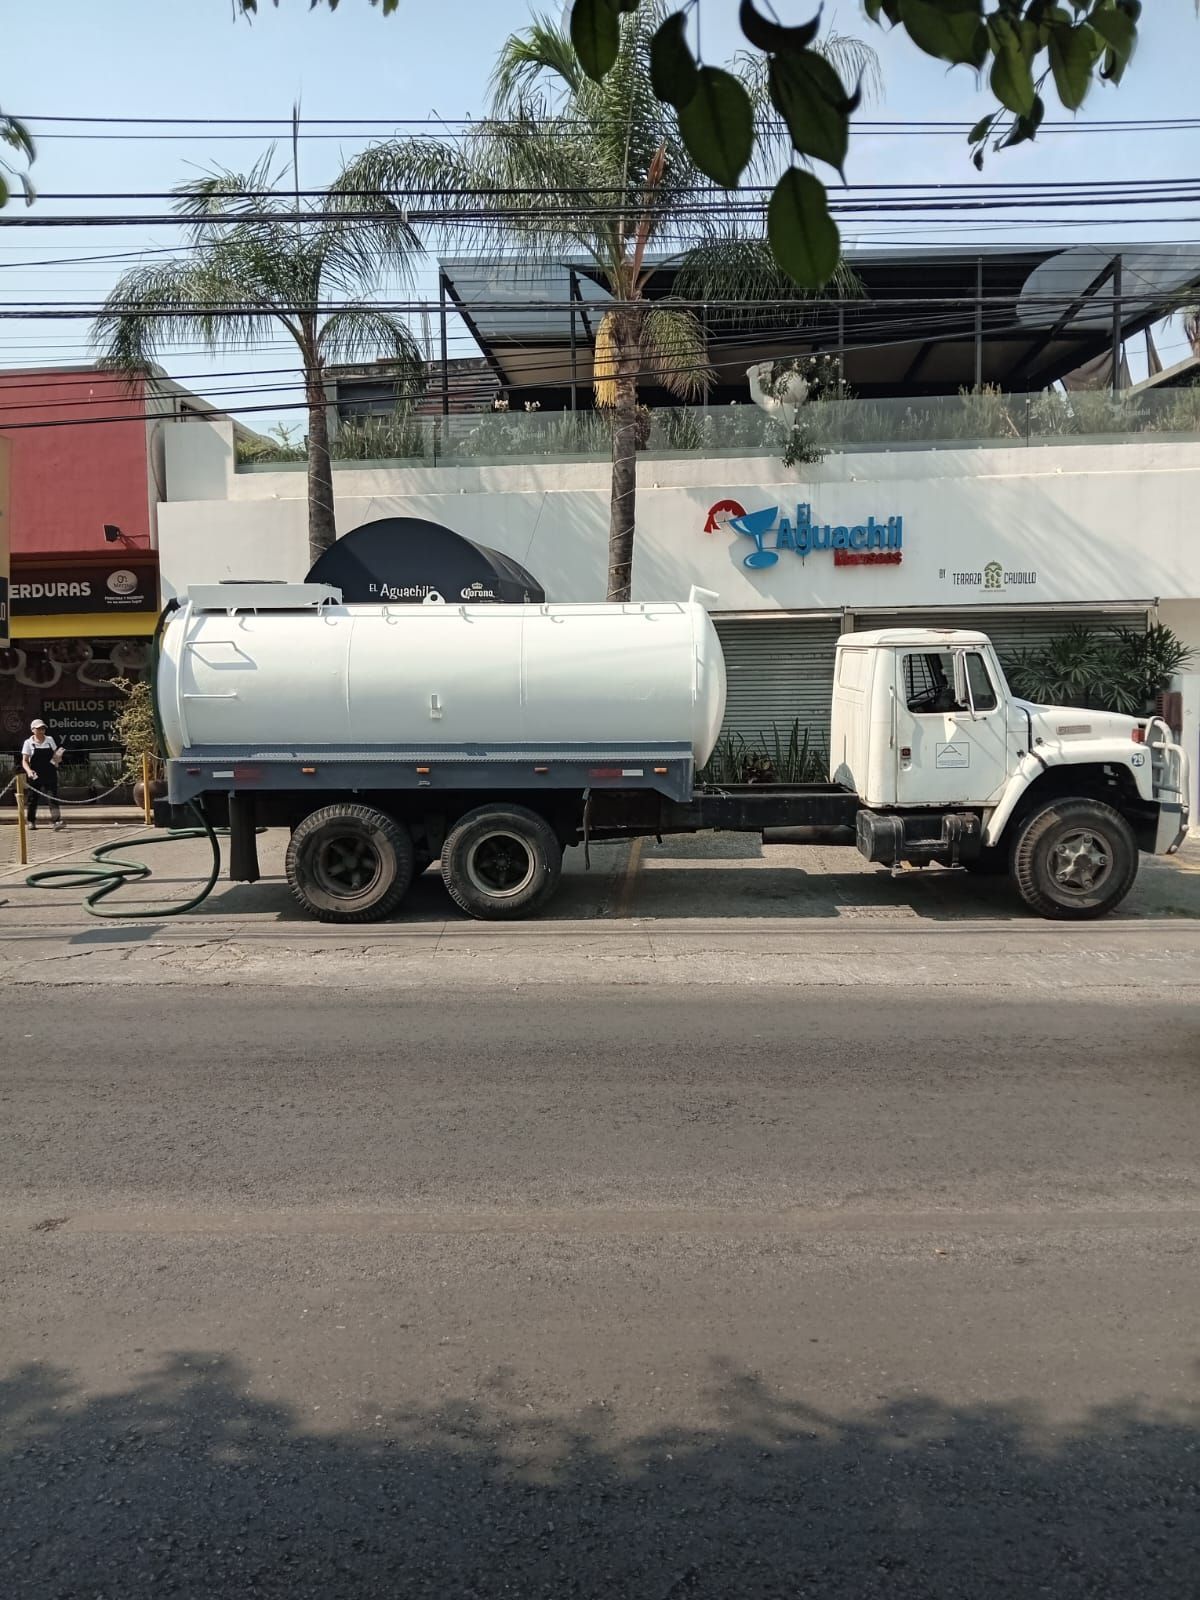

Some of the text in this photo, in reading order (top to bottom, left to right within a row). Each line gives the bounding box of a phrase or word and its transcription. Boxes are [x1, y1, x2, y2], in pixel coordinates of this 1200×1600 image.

[775, 516, 902, 557] Aguachil
[953, 572, 983, 585] TERRAZA
[1003, 571, 1037, 585] CAUDILLO
[8, 582, 92, 599] ERDURAS
[369, 583, 429, 600] EL Aguachil
[460, 587, 496, 600] Corona
[43, 700, 104, 712] PLATILLOS
[49, 717, 99, 729] Delicioso,
[59, 734, 67, 745] y
[70, 734, 88, 742] con
[91, 734, 105, 742] un
